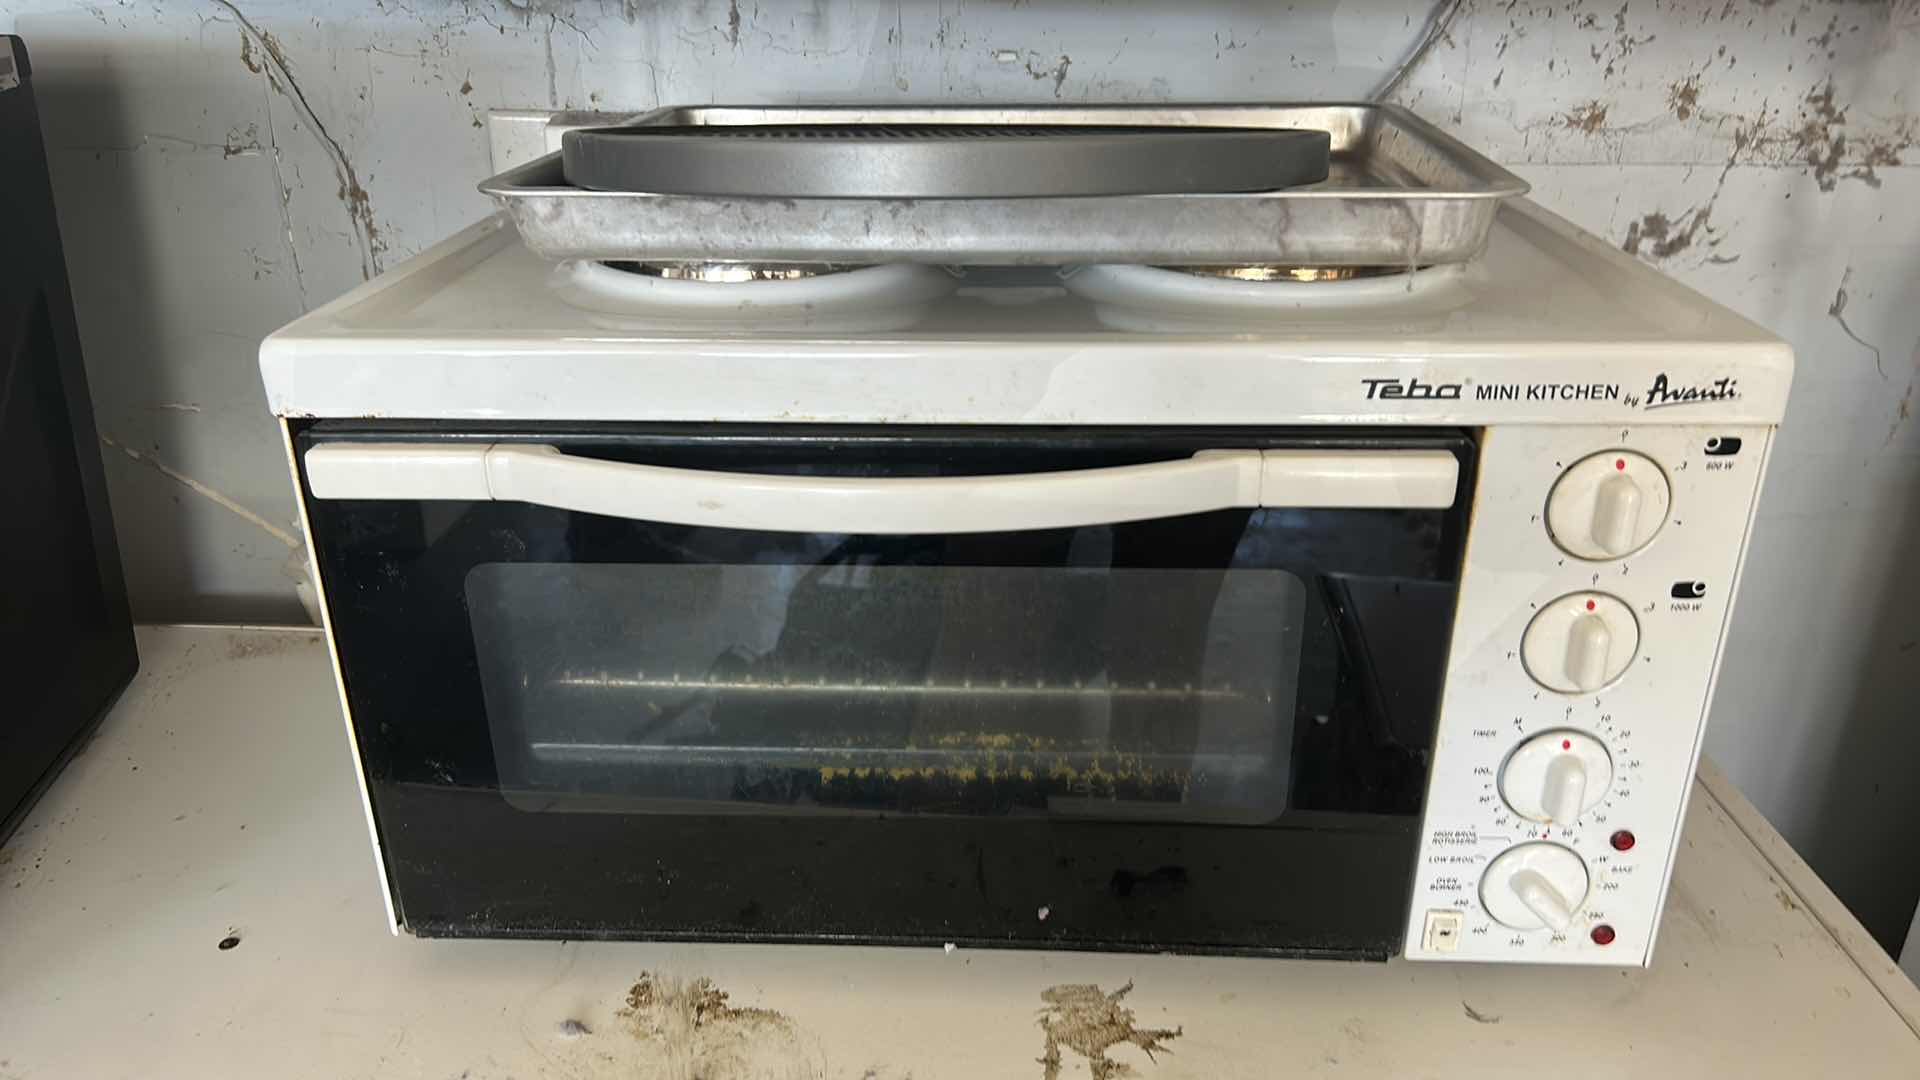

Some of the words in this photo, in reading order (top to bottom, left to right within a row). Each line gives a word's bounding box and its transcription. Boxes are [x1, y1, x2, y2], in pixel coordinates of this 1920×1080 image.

[1361, 378, 1462, 400] Teba
[1476, 384, 1520, 401] MINI
[1526, 384, 1619, 401] KITCHEN
[1623, 393, 1640, 408] by
[1428, 855, 1447, 863] LOW
